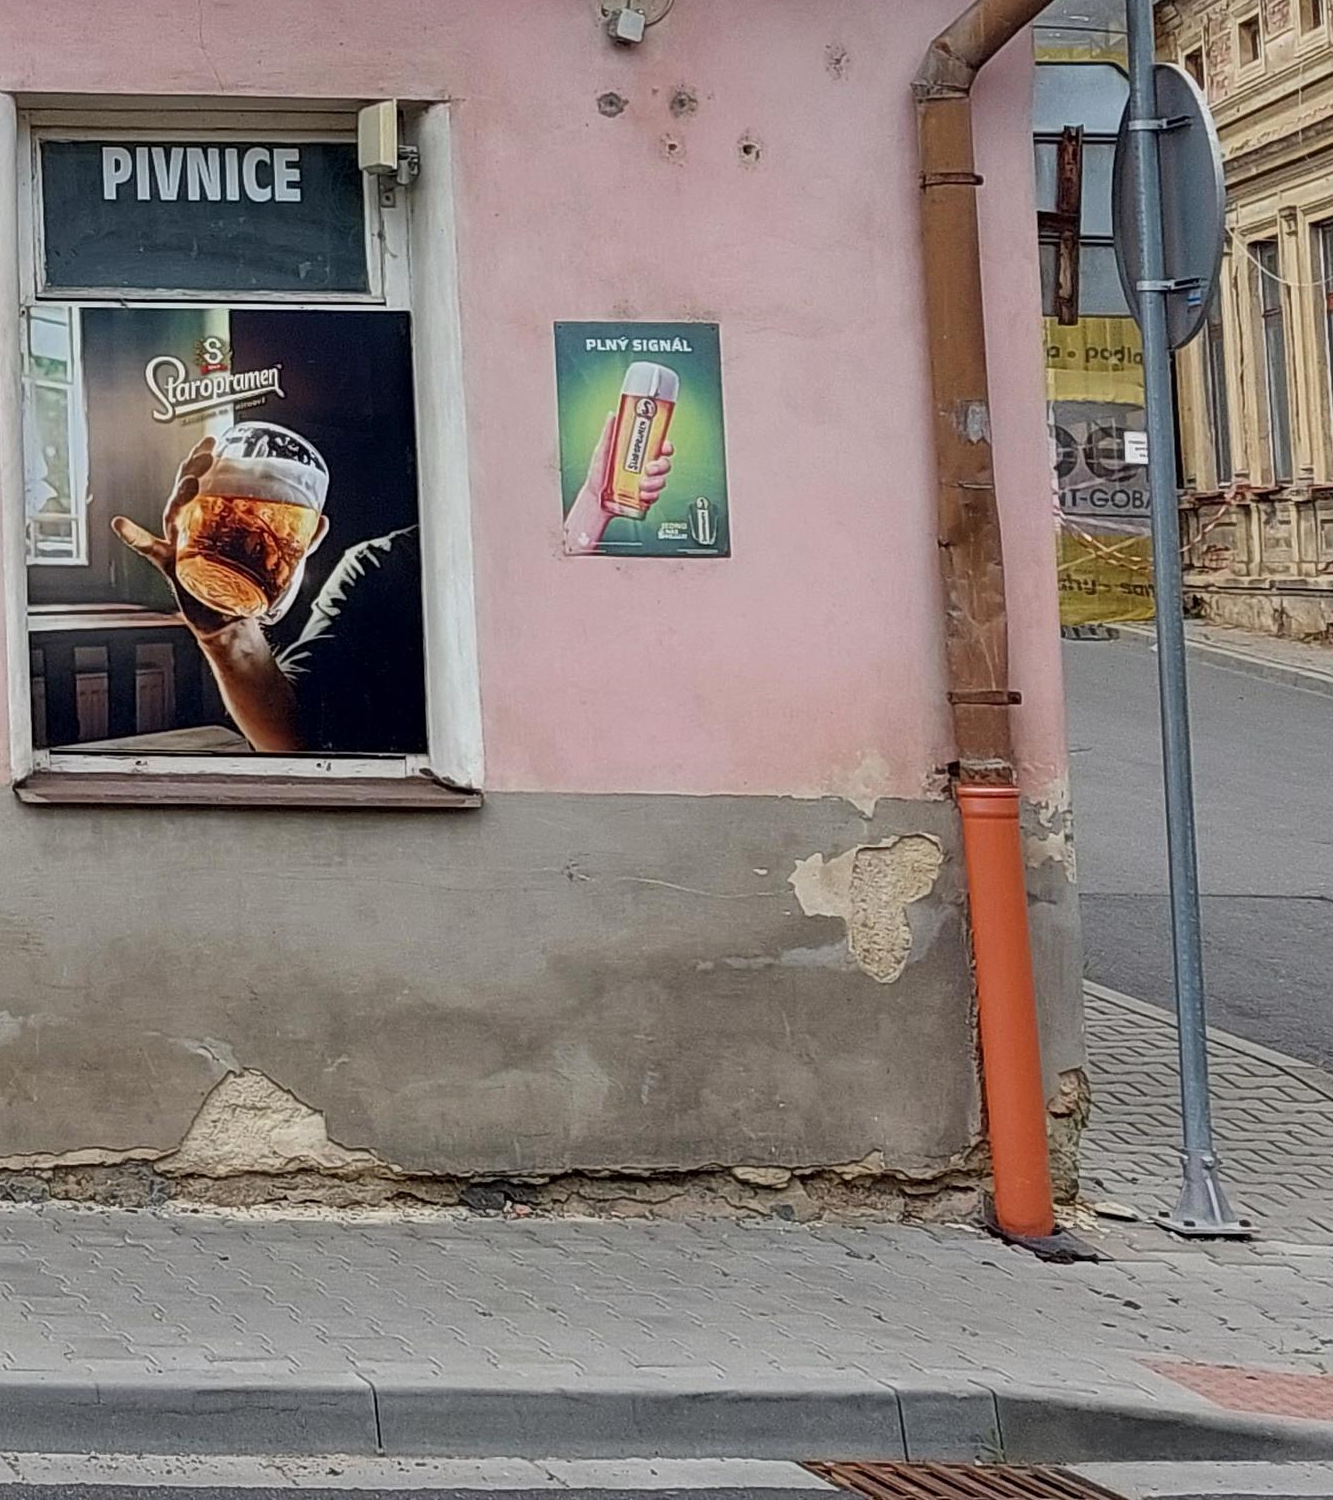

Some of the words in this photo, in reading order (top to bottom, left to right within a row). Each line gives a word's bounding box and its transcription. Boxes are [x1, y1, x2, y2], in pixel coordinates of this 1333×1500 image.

[101, 146, 302, 202] PIVNICE
[585, 336, 630, 351] PLNÝ
[632, 336, 693, 352] SIGNÁL
[145, 356, 286, 421] Staropramen
